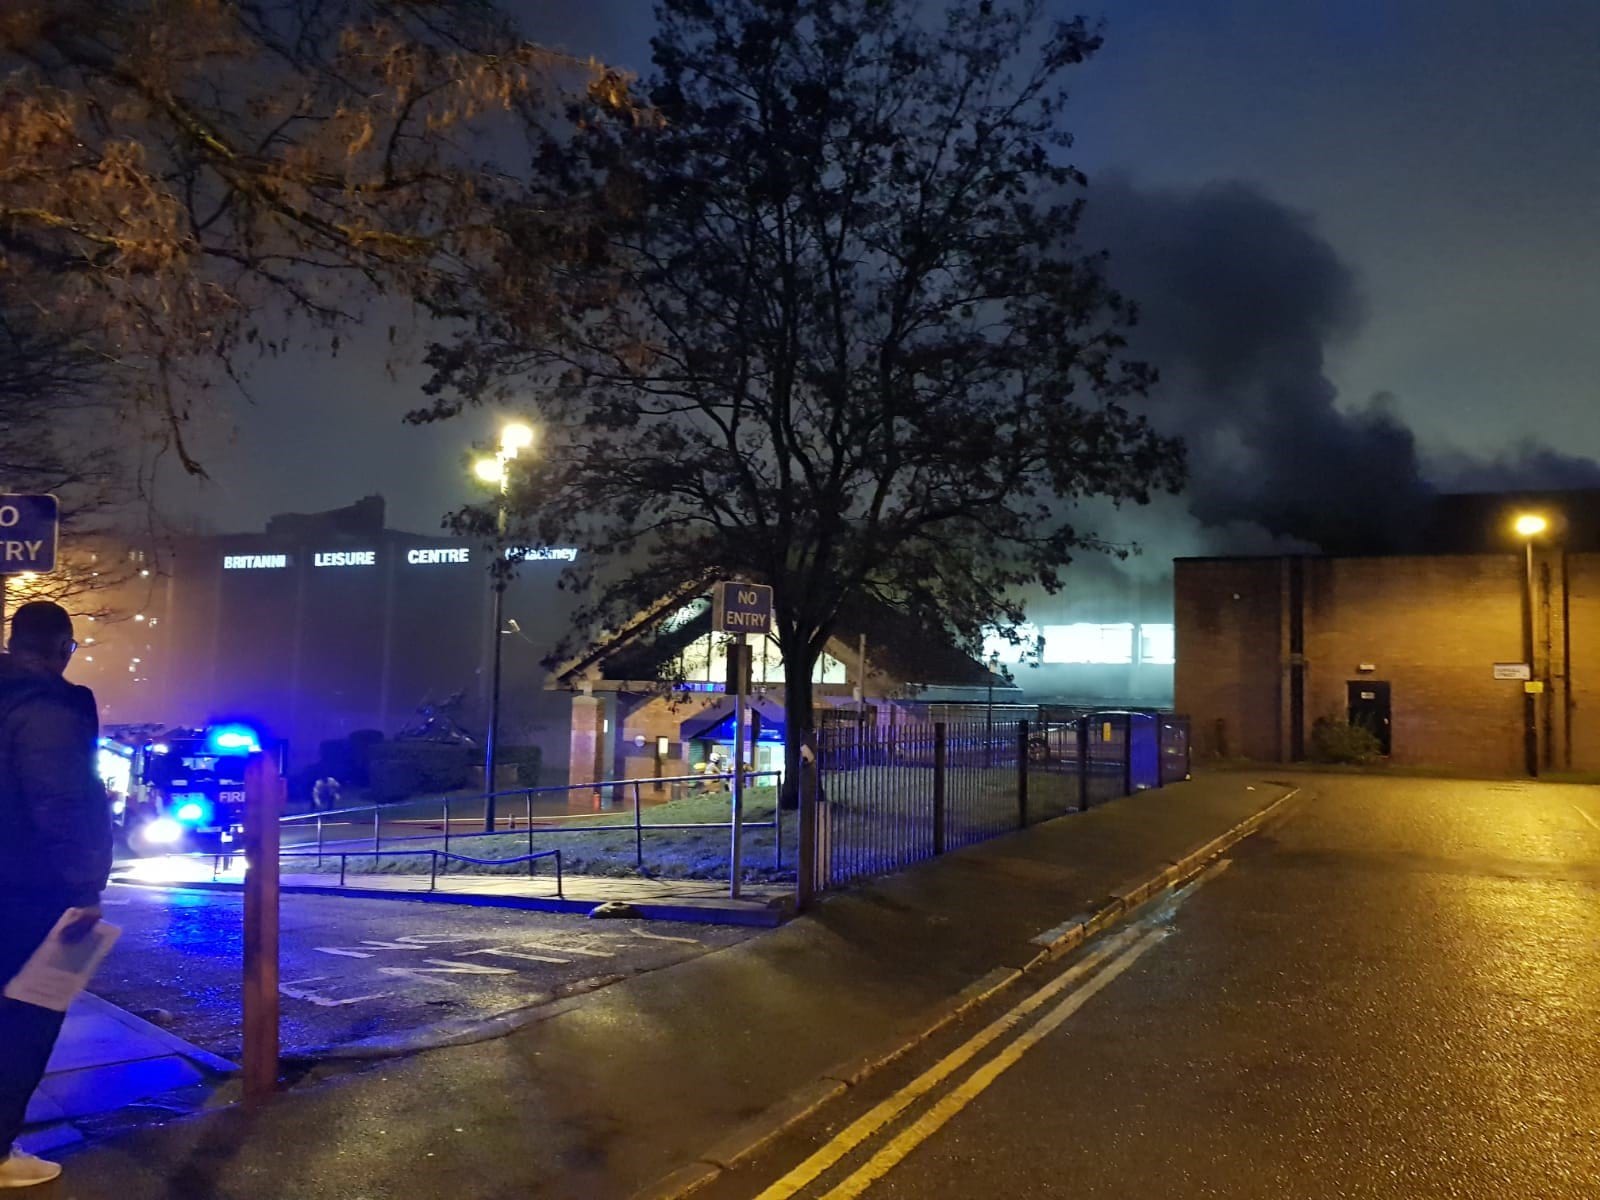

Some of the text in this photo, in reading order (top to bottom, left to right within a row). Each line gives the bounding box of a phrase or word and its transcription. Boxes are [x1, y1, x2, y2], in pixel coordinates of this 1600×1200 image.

[314, 551, 376, 567] LEISURE
[407, 548, 470, 565] CENTRE
[738, 591, 757, 605] NO
[727, 611, 766, 627] ENTRY
[219, 791, 246, 803] FIR
